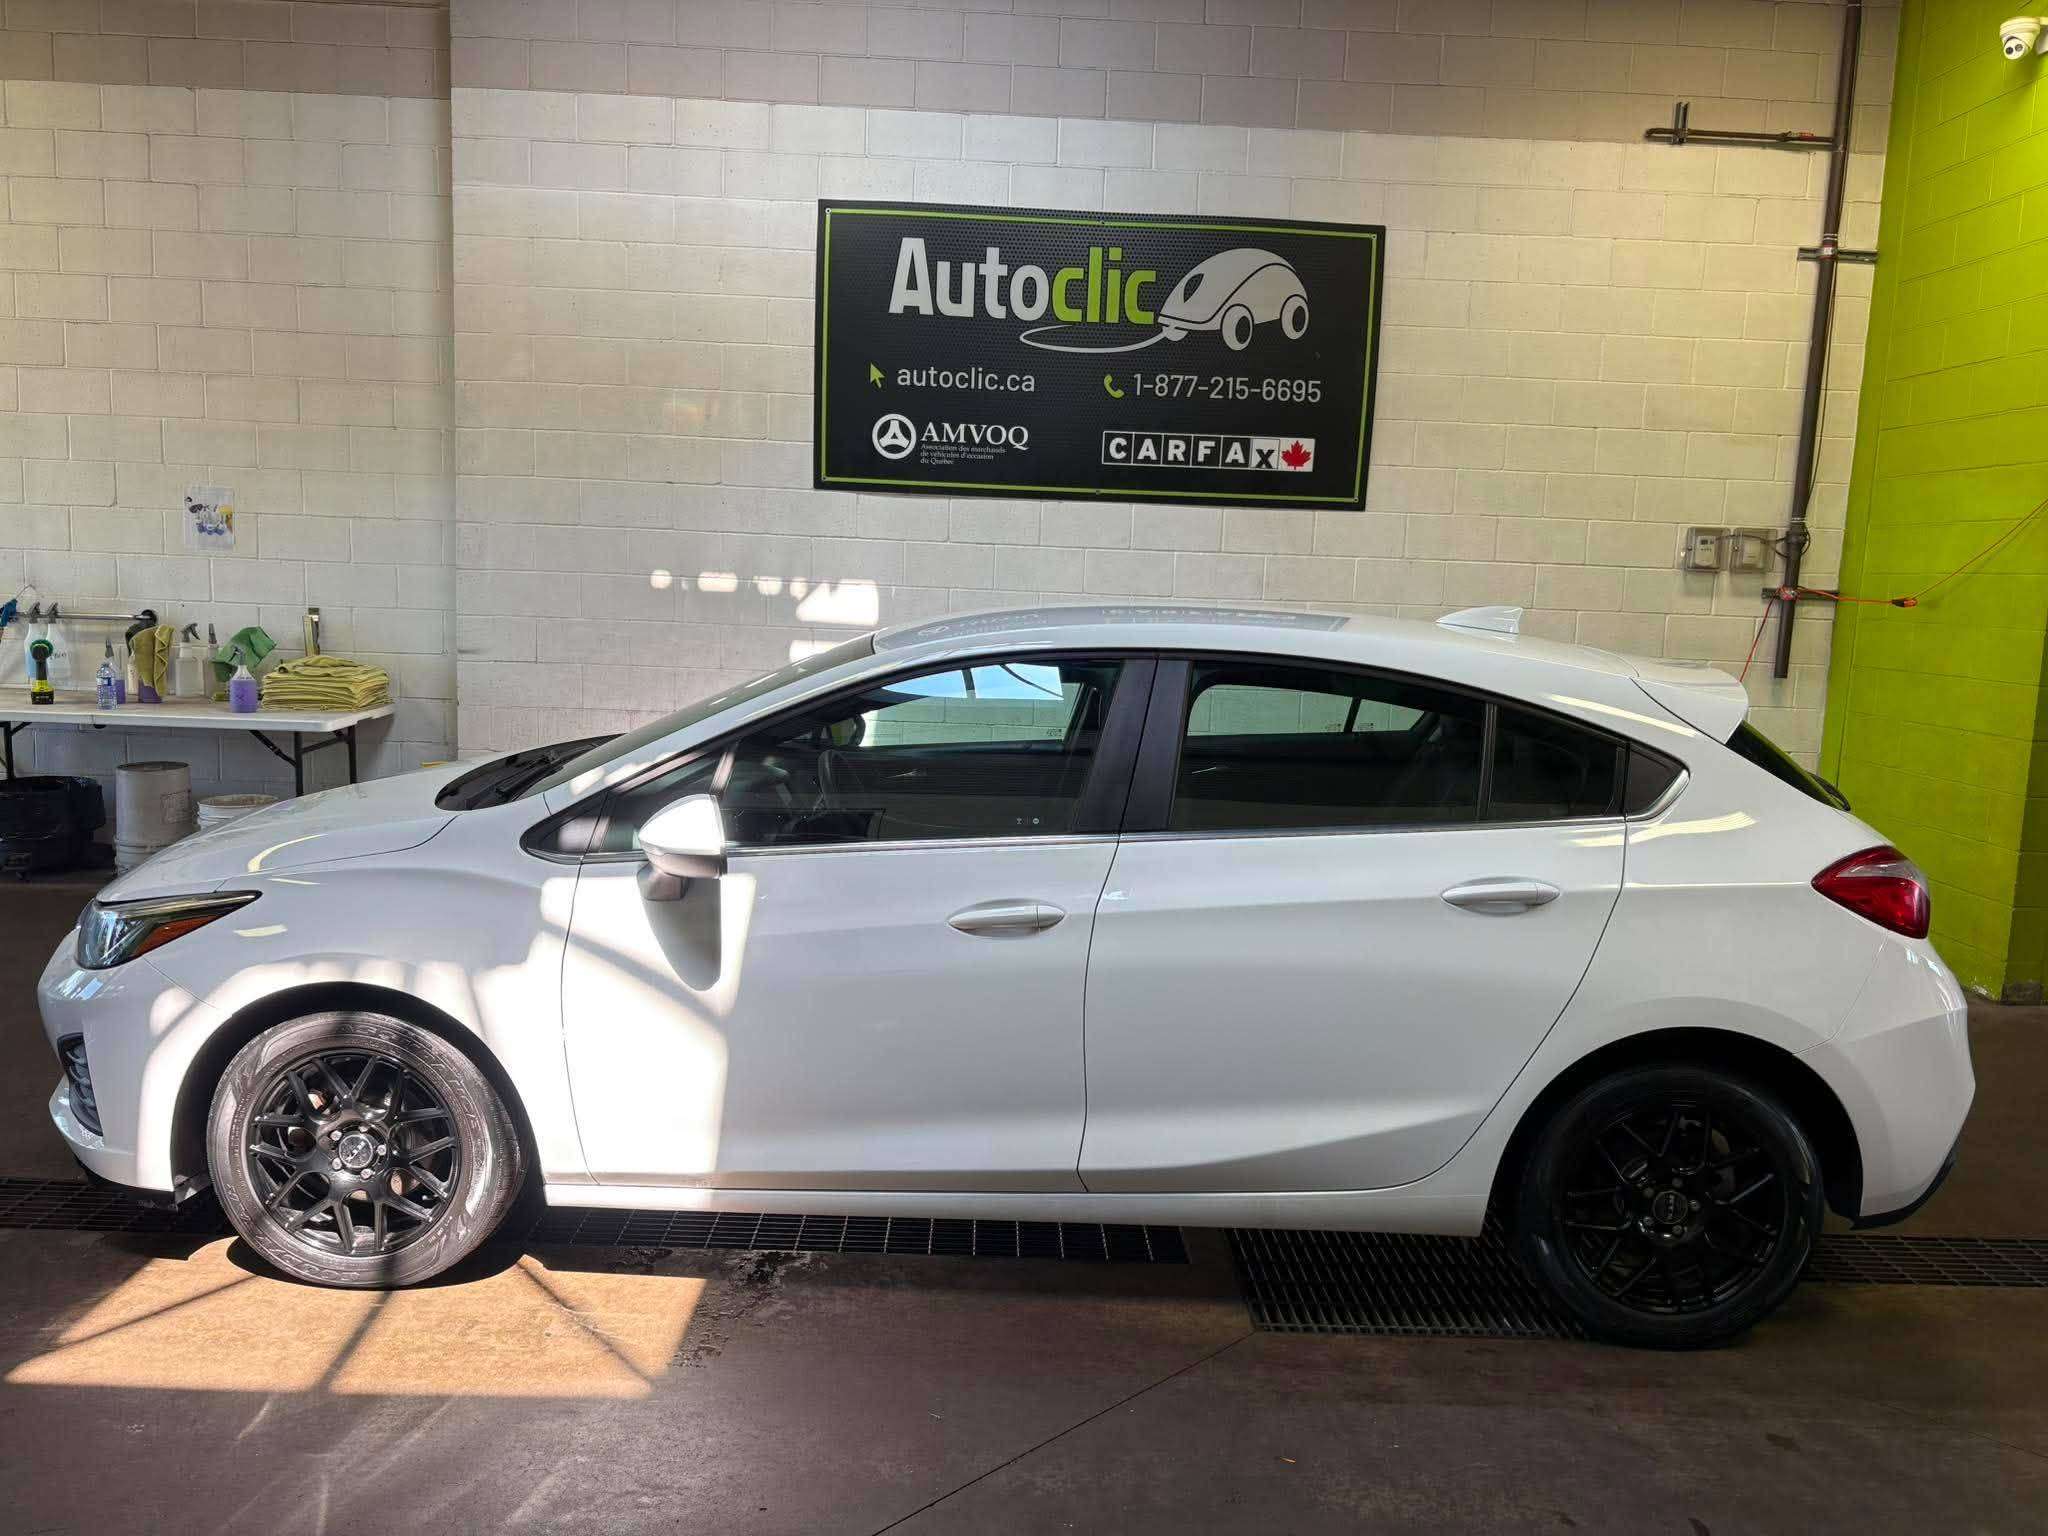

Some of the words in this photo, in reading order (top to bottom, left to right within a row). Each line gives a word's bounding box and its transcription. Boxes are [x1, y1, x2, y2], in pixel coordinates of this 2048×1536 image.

[888, 236, 1157, 325] Autoclic
[897, 366, 1035, 392] autoclic.ca
[1133, 373, 1322, 403] 1-877-215-6695
[920, 421, 1029, 450] AMVOQ
[1108, 437, 1275, 469] CARFAX
